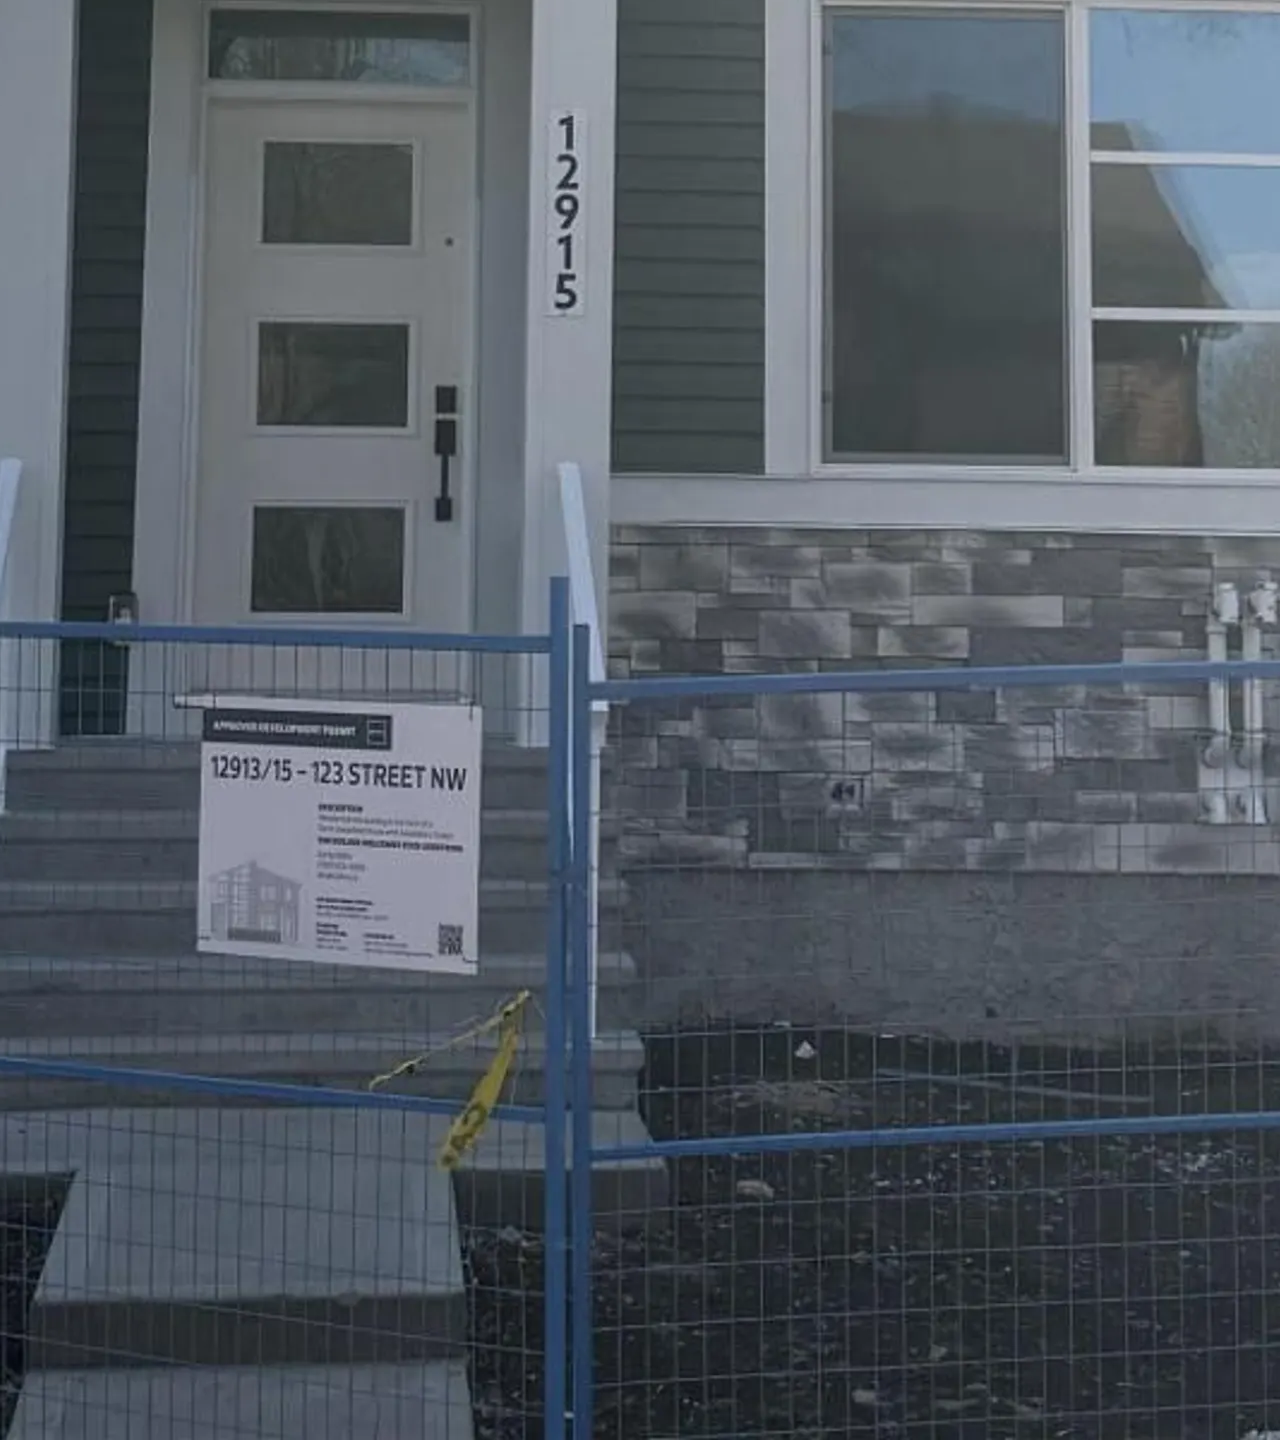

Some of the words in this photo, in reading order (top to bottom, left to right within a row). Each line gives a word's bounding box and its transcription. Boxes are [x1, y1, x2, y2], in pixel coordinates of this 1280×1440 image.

[554, 115, 580, 310] 12915
[210, 755, 292, 782] 12913/15
[312, 760, 344, 785] 123
[349, 762, 427, 789] STREET
[431, 767, 467, 792] NW
